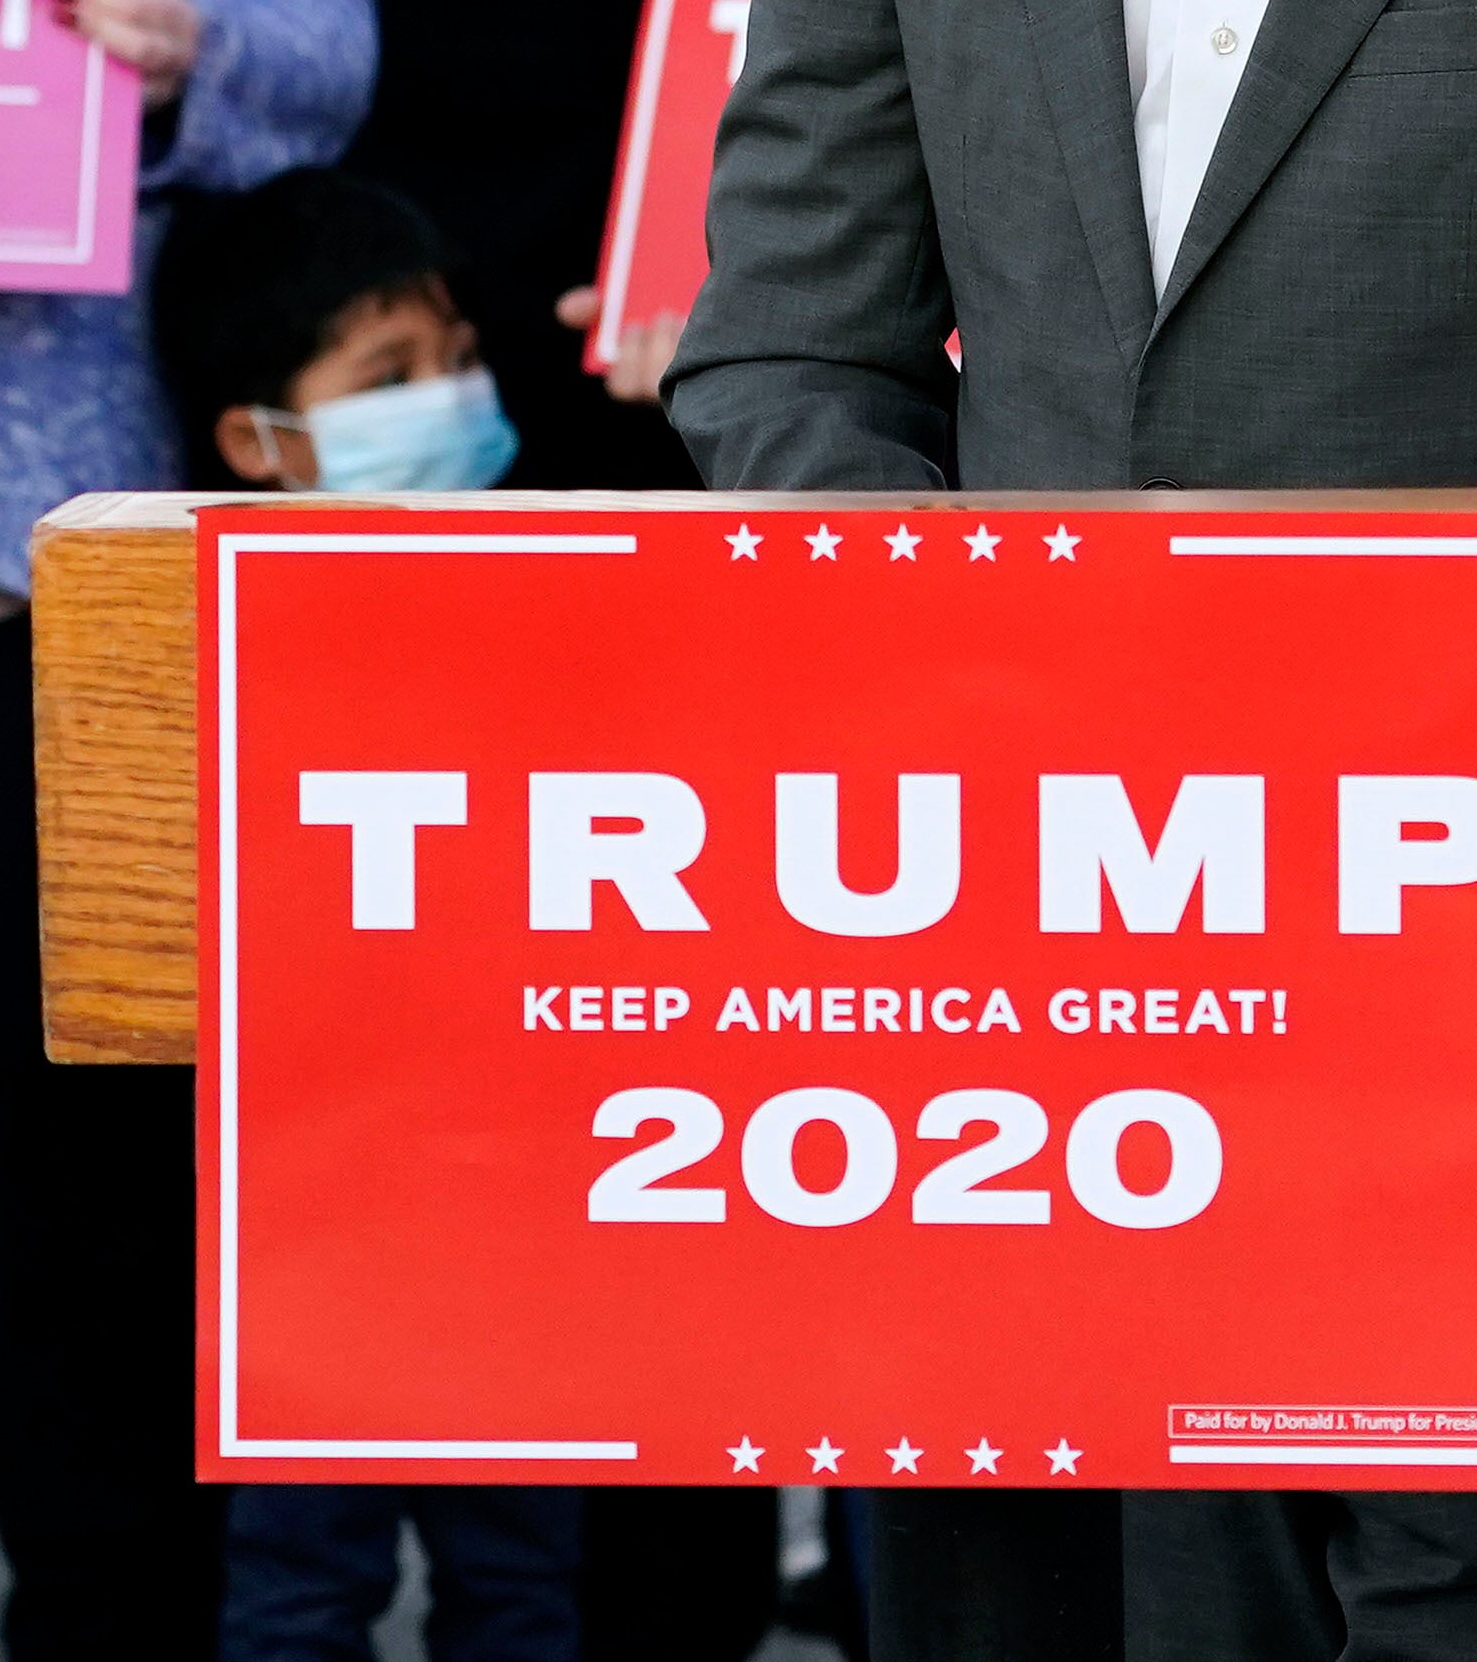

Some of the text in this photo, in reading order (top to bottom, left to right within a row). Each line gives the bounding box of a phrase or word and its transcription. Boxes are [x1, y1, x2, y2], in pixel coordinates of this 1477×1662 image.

[522, 986, 1289, 1036] KEEP AMERICA GREAT!
[586, 1085, 1224, 1231] 2020
[1184, 1411, 1222, 1430] Paid
[1223, 1411, 1248, 1430] for
[1250, 1412, 1272, 1433] by
[1273, 1412, 1334, 1431] Donald
[1336, 1413, 1349, 1431] J.
[1352, 1412, 1407, 1434] Trump
[1408, 1413, 1432, 1432] for
